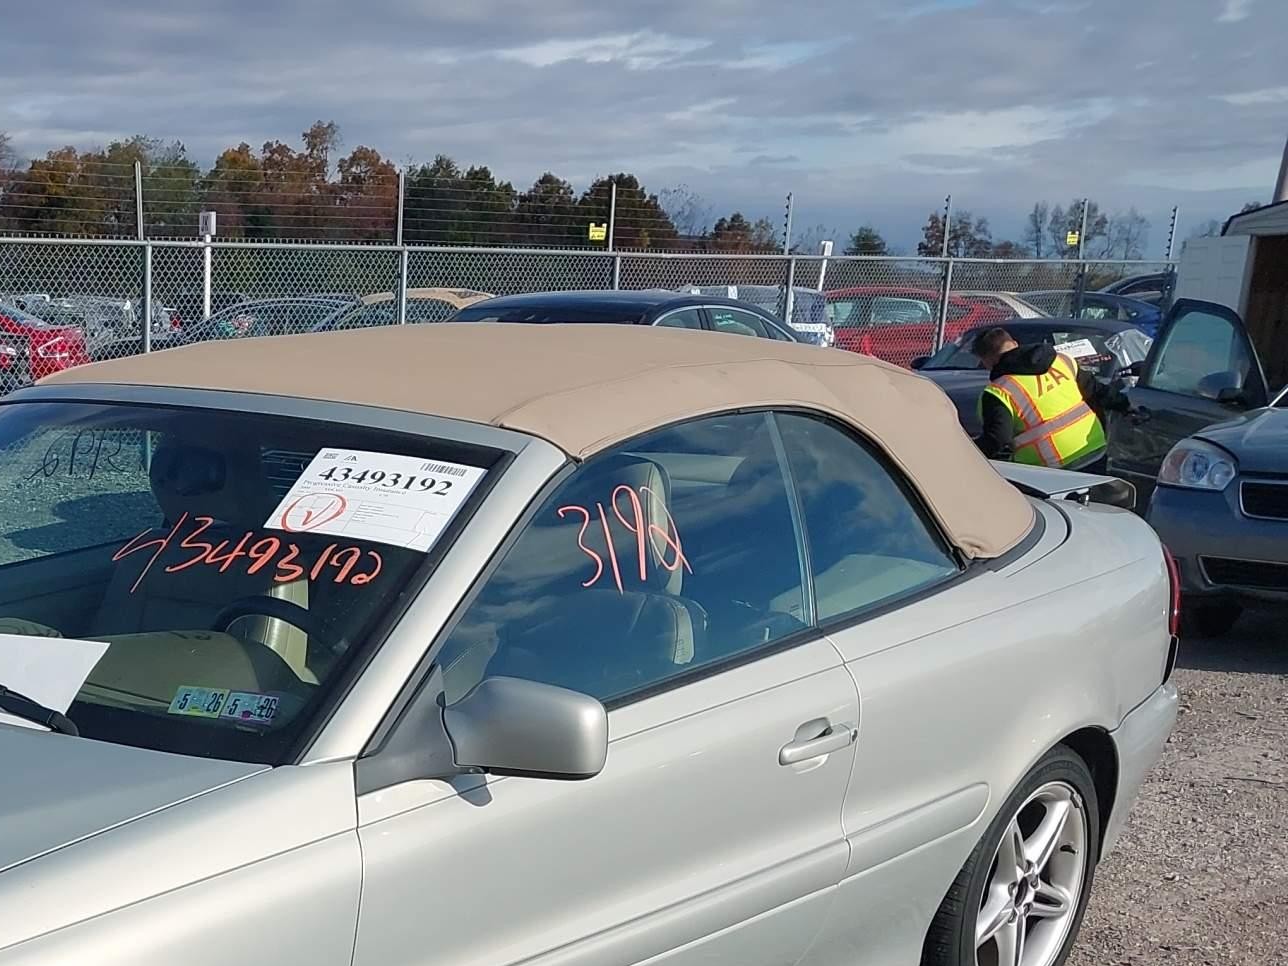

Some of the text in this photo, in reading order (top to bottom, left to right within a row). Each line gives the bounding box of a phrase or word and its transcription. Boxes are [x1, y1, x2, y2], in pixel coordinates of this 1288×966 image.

[318, 465, 454, 498] 43493192
[111, 511, 383, 594] 43493192
[557, 485, 694, 597] 3192
[206, 692, 225, 713] 26
